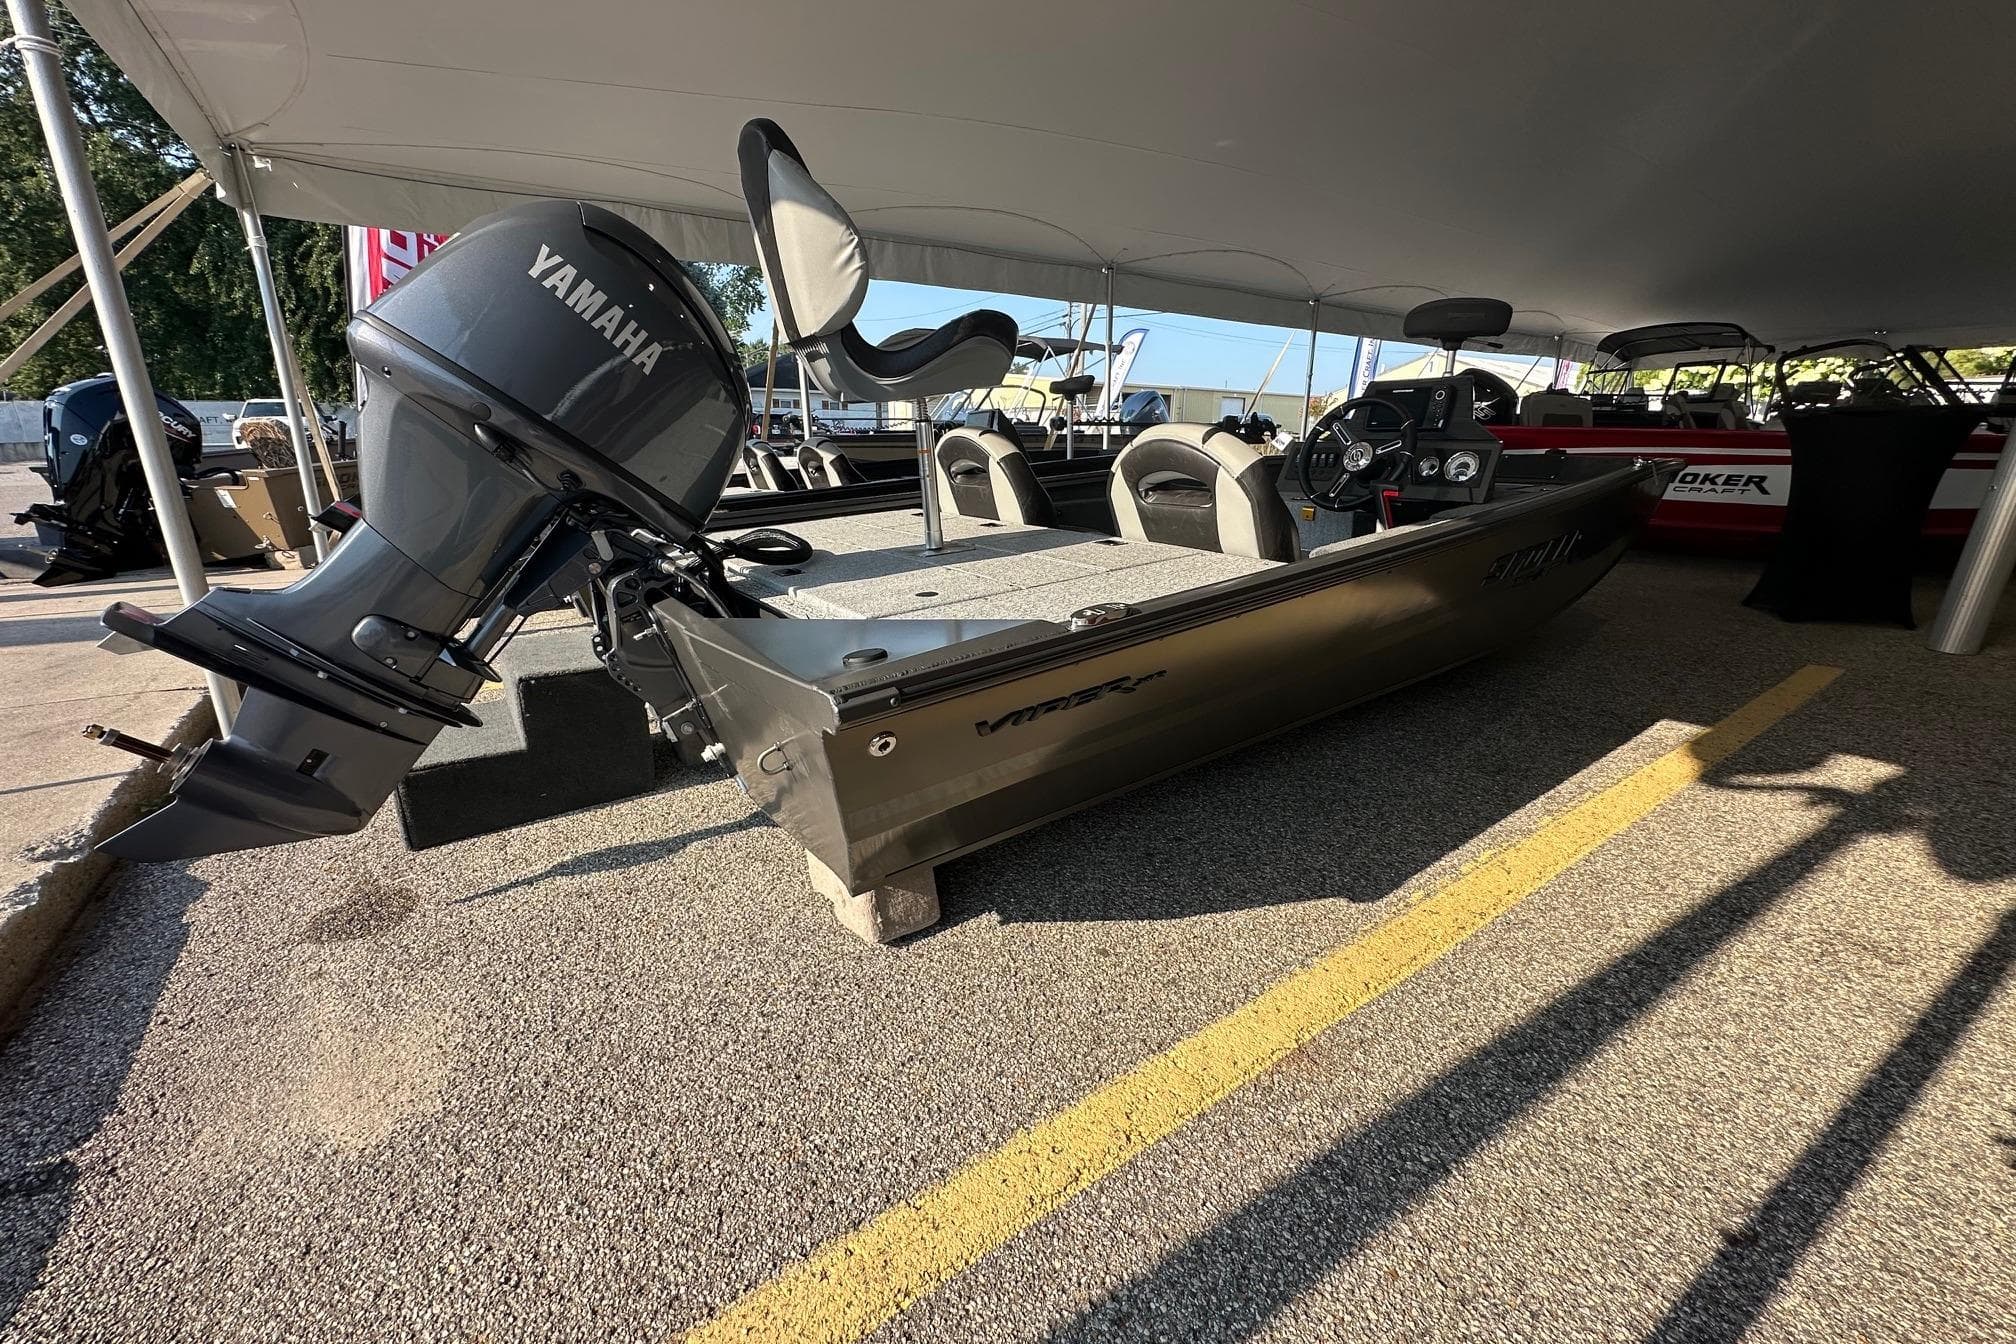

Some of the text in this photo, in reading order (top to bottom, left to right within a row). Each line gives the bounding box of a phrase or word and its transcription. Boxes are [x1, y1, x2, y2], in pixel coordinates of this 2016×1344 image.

[528, 243, 664, 376] YAMAHA
[158, 411, 197, 438] CURY
[1668, 471, 1771, 496] OKER
[1672, 486, 1751, 495] CRAFT
